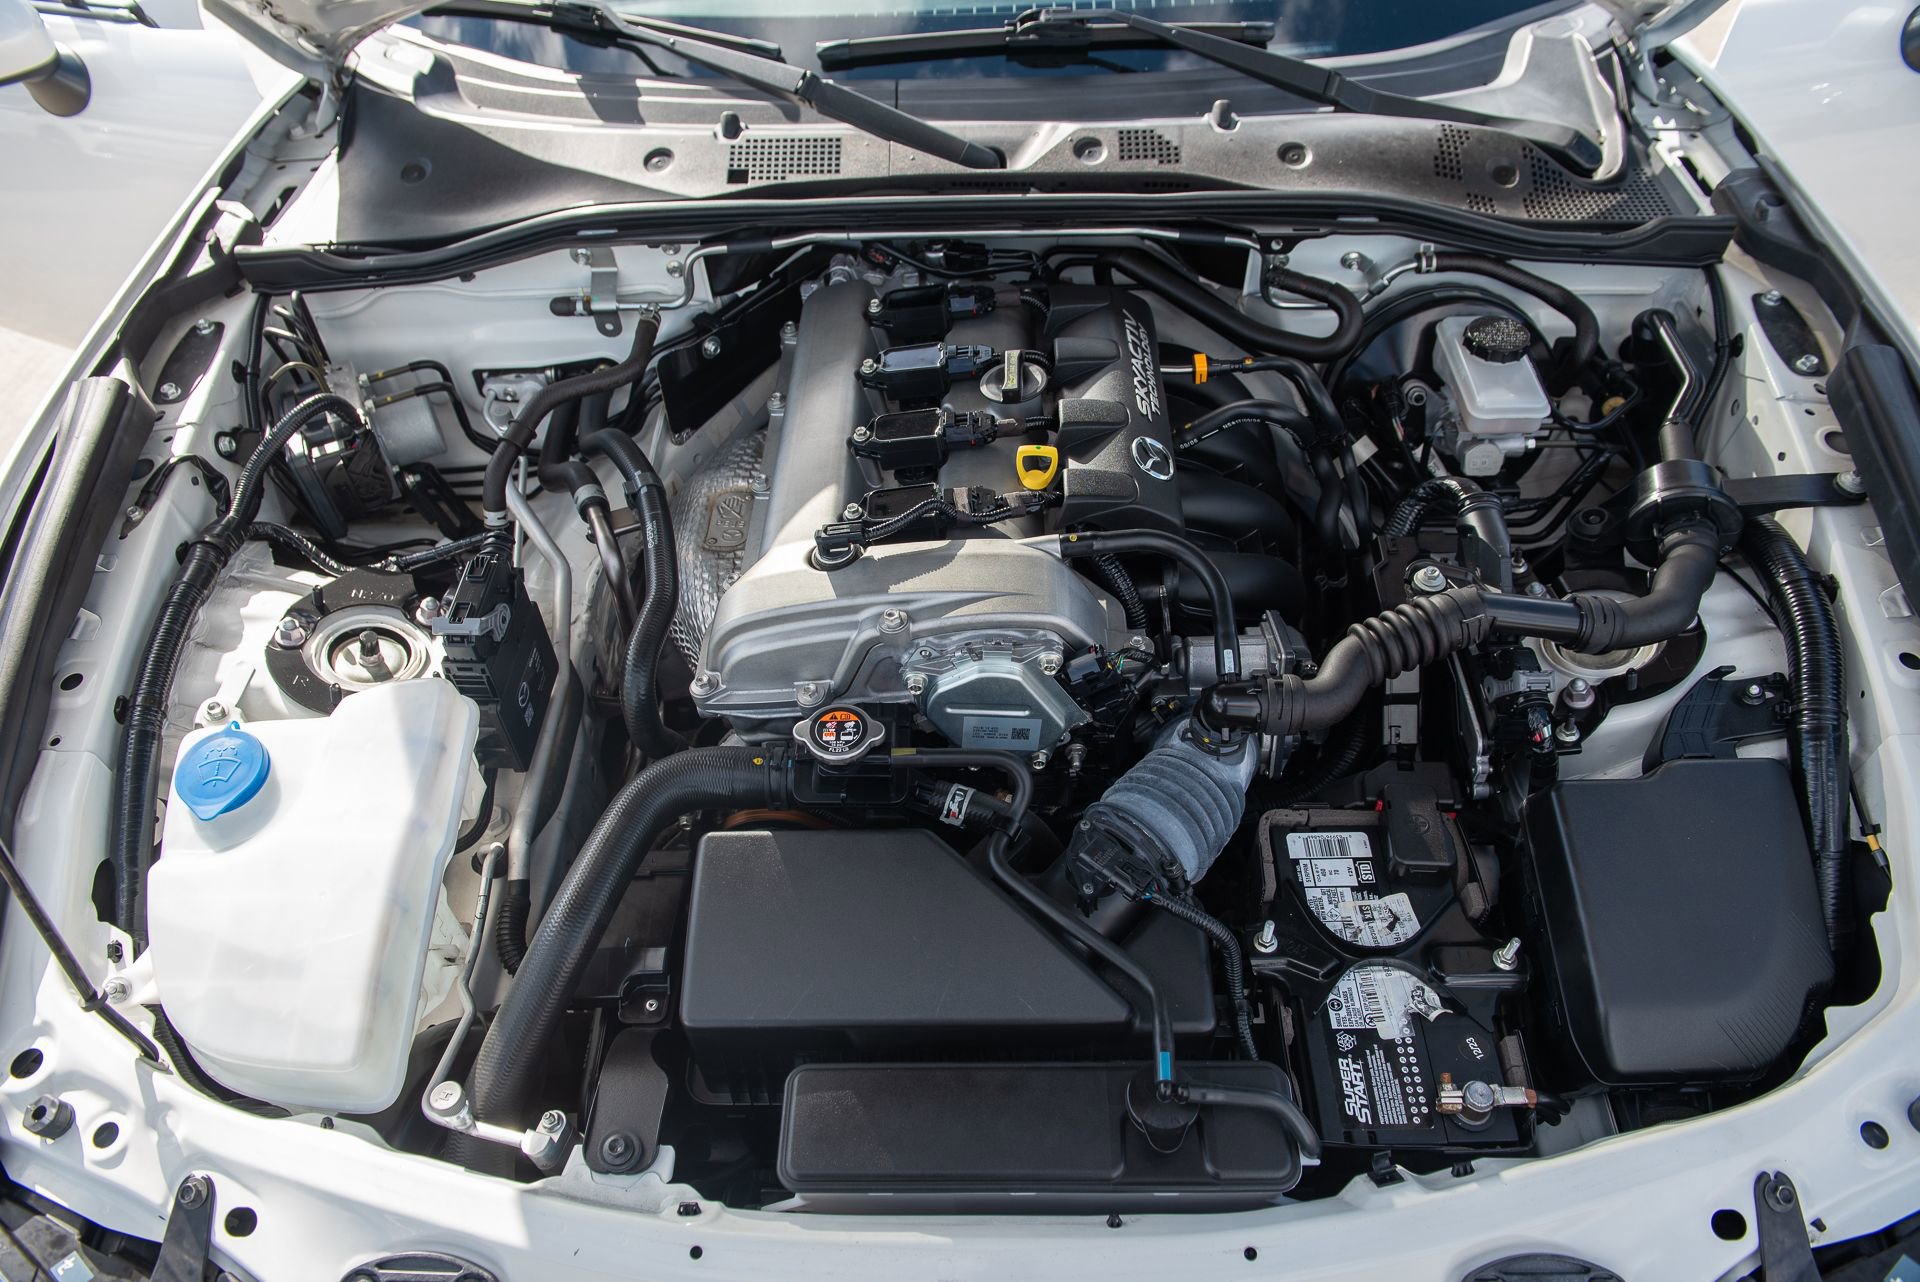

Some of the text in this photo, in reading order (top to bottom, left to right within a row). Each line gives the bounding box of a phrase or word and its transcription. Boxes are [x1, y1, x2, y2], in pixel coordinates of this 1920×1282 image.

[1122, 308, 1153, 423] SKYACTIV
[1137, 322, 1161, 416] TECHNOLOGY
[1360, 864, 1373, 880] STD
[1334, 1013, 1342, 1027] SHIELD
[1345, 1004, 1354, 1027] EXPLOSIVE
[1466, 1037, 1484, 1060] 12/23
[1338, 1057, 1357, 1117] SUPER
[1351, 1061, 1373, 1125] START
